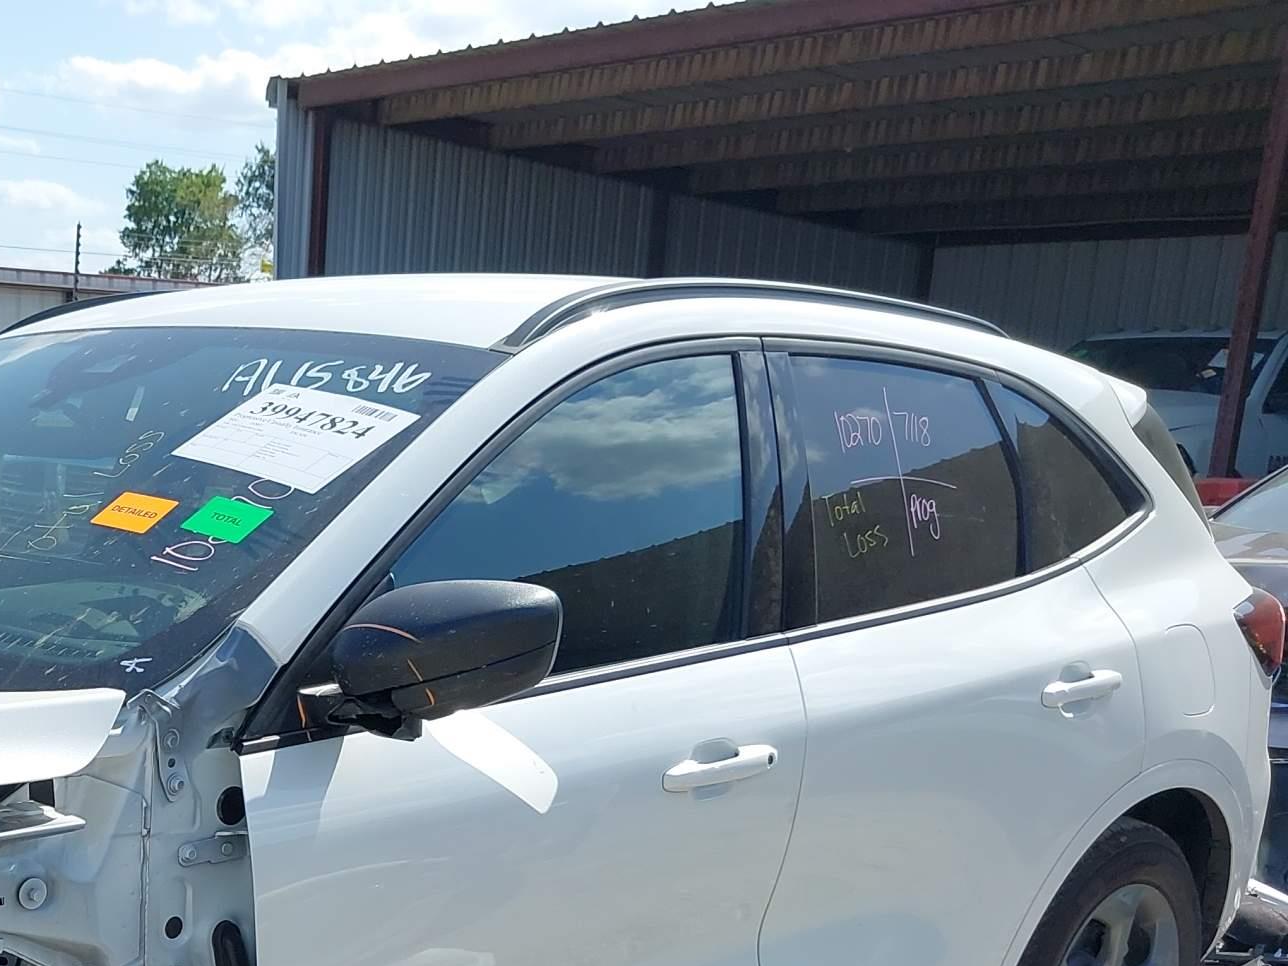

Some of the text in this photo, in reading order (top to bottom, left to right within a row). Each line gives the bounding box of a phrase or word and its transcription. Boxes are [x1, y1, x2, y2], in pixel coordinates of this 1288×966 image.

[249, 401, 376, 440] 39947824
[834, 411, 882, 454] 10270
[111, 504, 158, 520] DETAILED
[212, 511, 243, 528] TOTAL
[821, 491, 866, 527] Total
